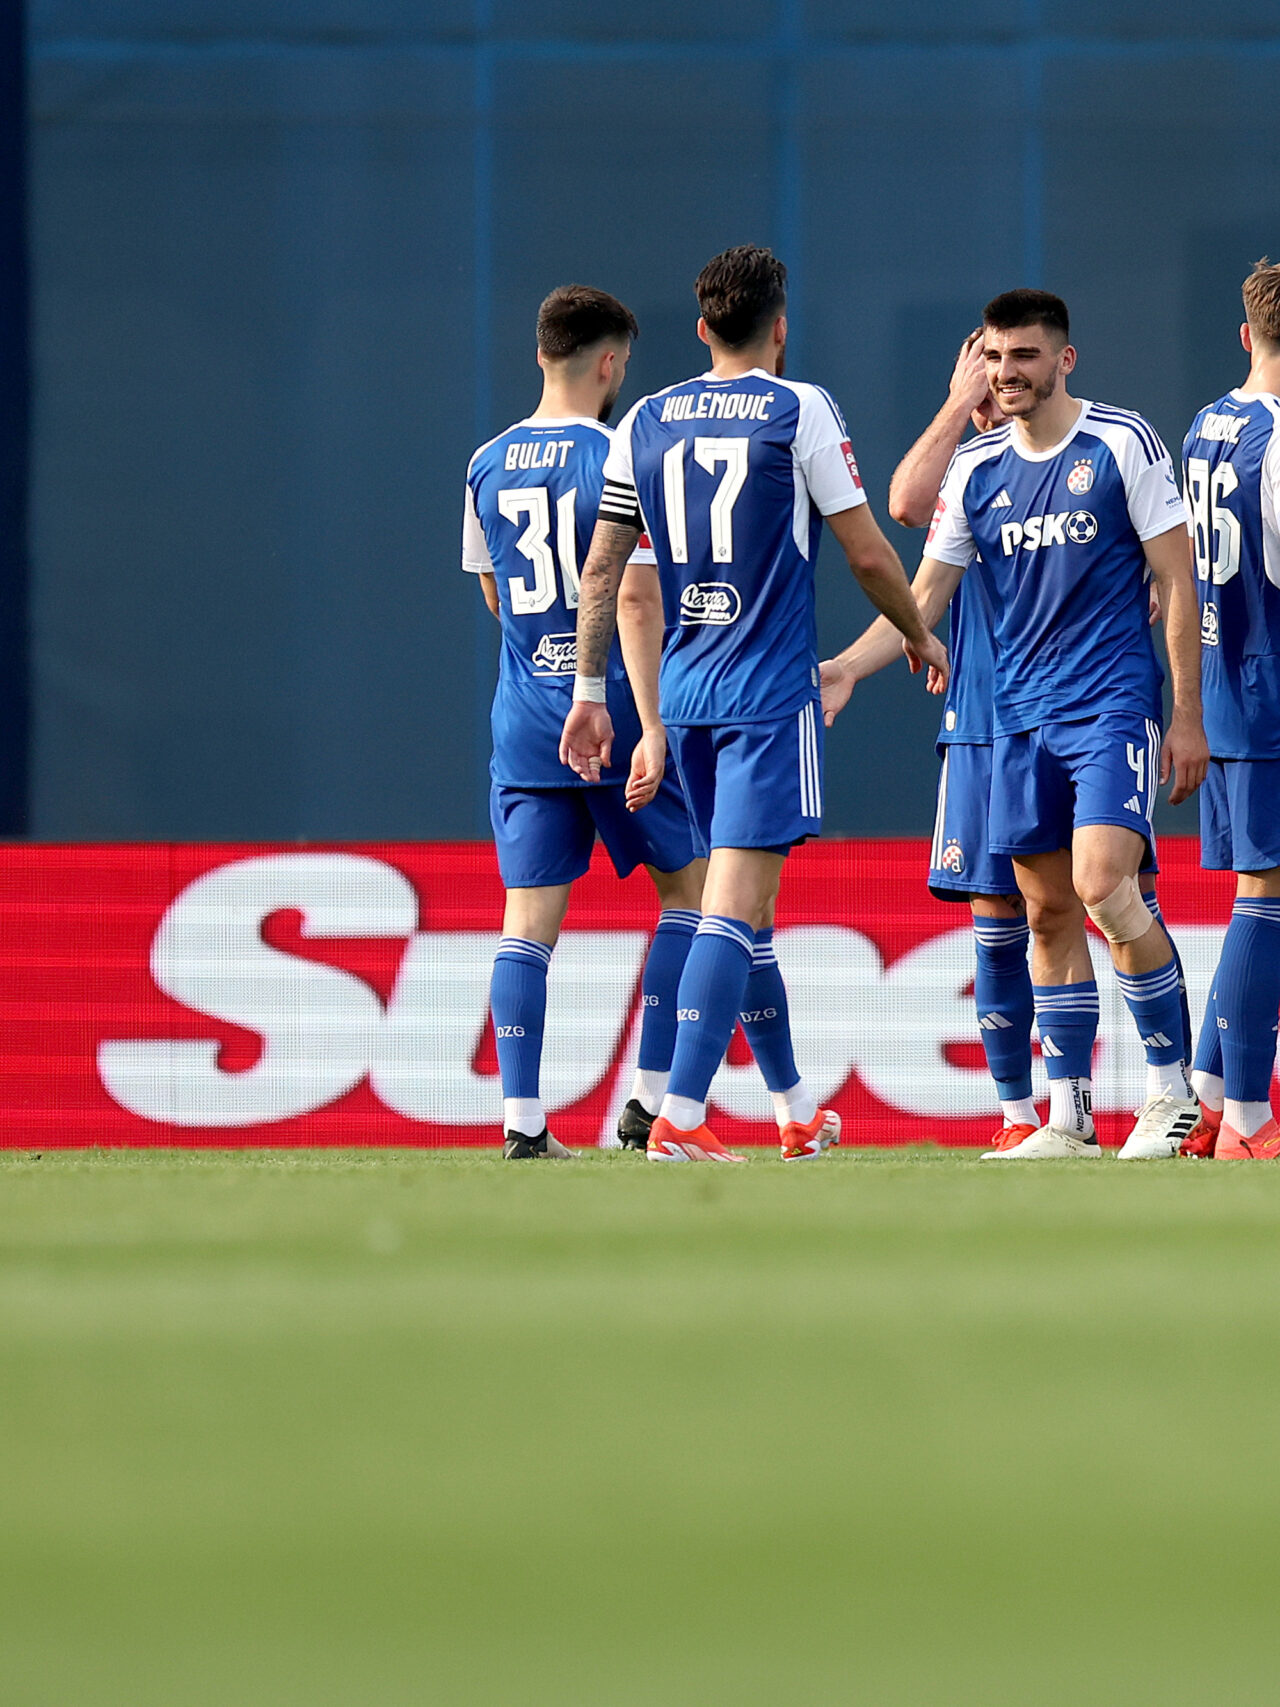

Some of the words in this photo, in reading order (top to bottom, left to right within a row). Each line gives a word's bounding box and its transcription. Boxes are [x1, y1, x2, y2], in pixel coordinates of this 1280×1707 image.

[660, 391, 775, 422] KULENOVIĆ
[504, 440, 575, 471] BULAT
[663, 436, 750, 564] 17
[1188, 457, 1241, 586] 86
[498, 486, 581, 615] 31
[1126, 742, 1145, 793] 4
[497, 1025, 526, 1039] DZG
[739, 1008, 777, 1023] DZG
